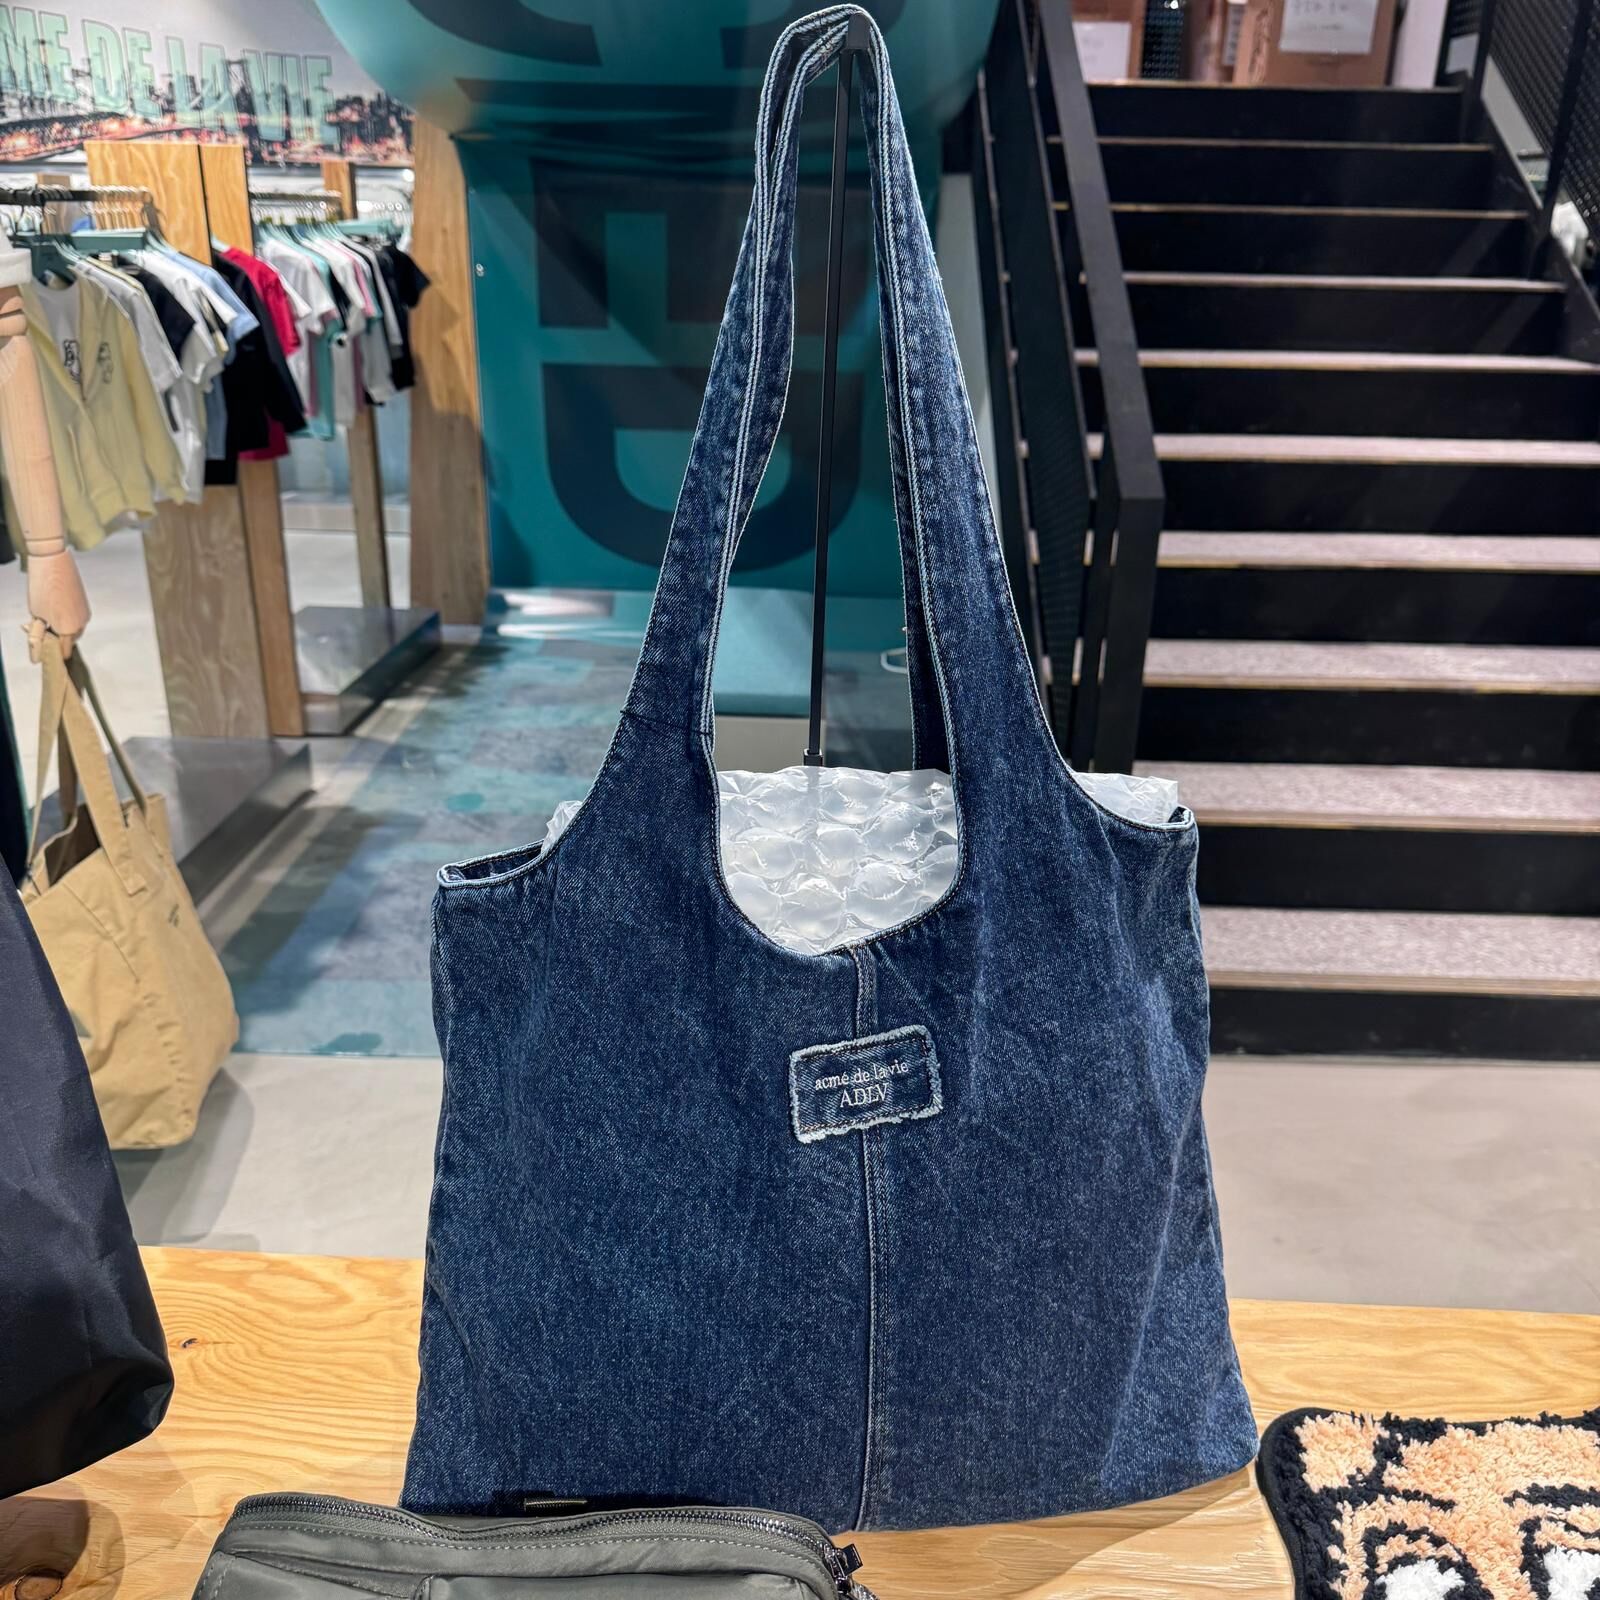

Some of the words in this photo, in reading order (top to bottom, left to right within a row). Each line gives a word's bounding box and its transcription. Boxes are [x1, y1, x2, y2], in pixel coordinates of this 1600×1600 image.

[82, 19, 162, 118] DE
[165, 35, 240, 133] LA
[241, 49, 341, 145] VIE
[853, 1068, 870, 1083] de
[887, 1059, 909, 1075] vie
[840, 1082, 889, 1108] ADLV
